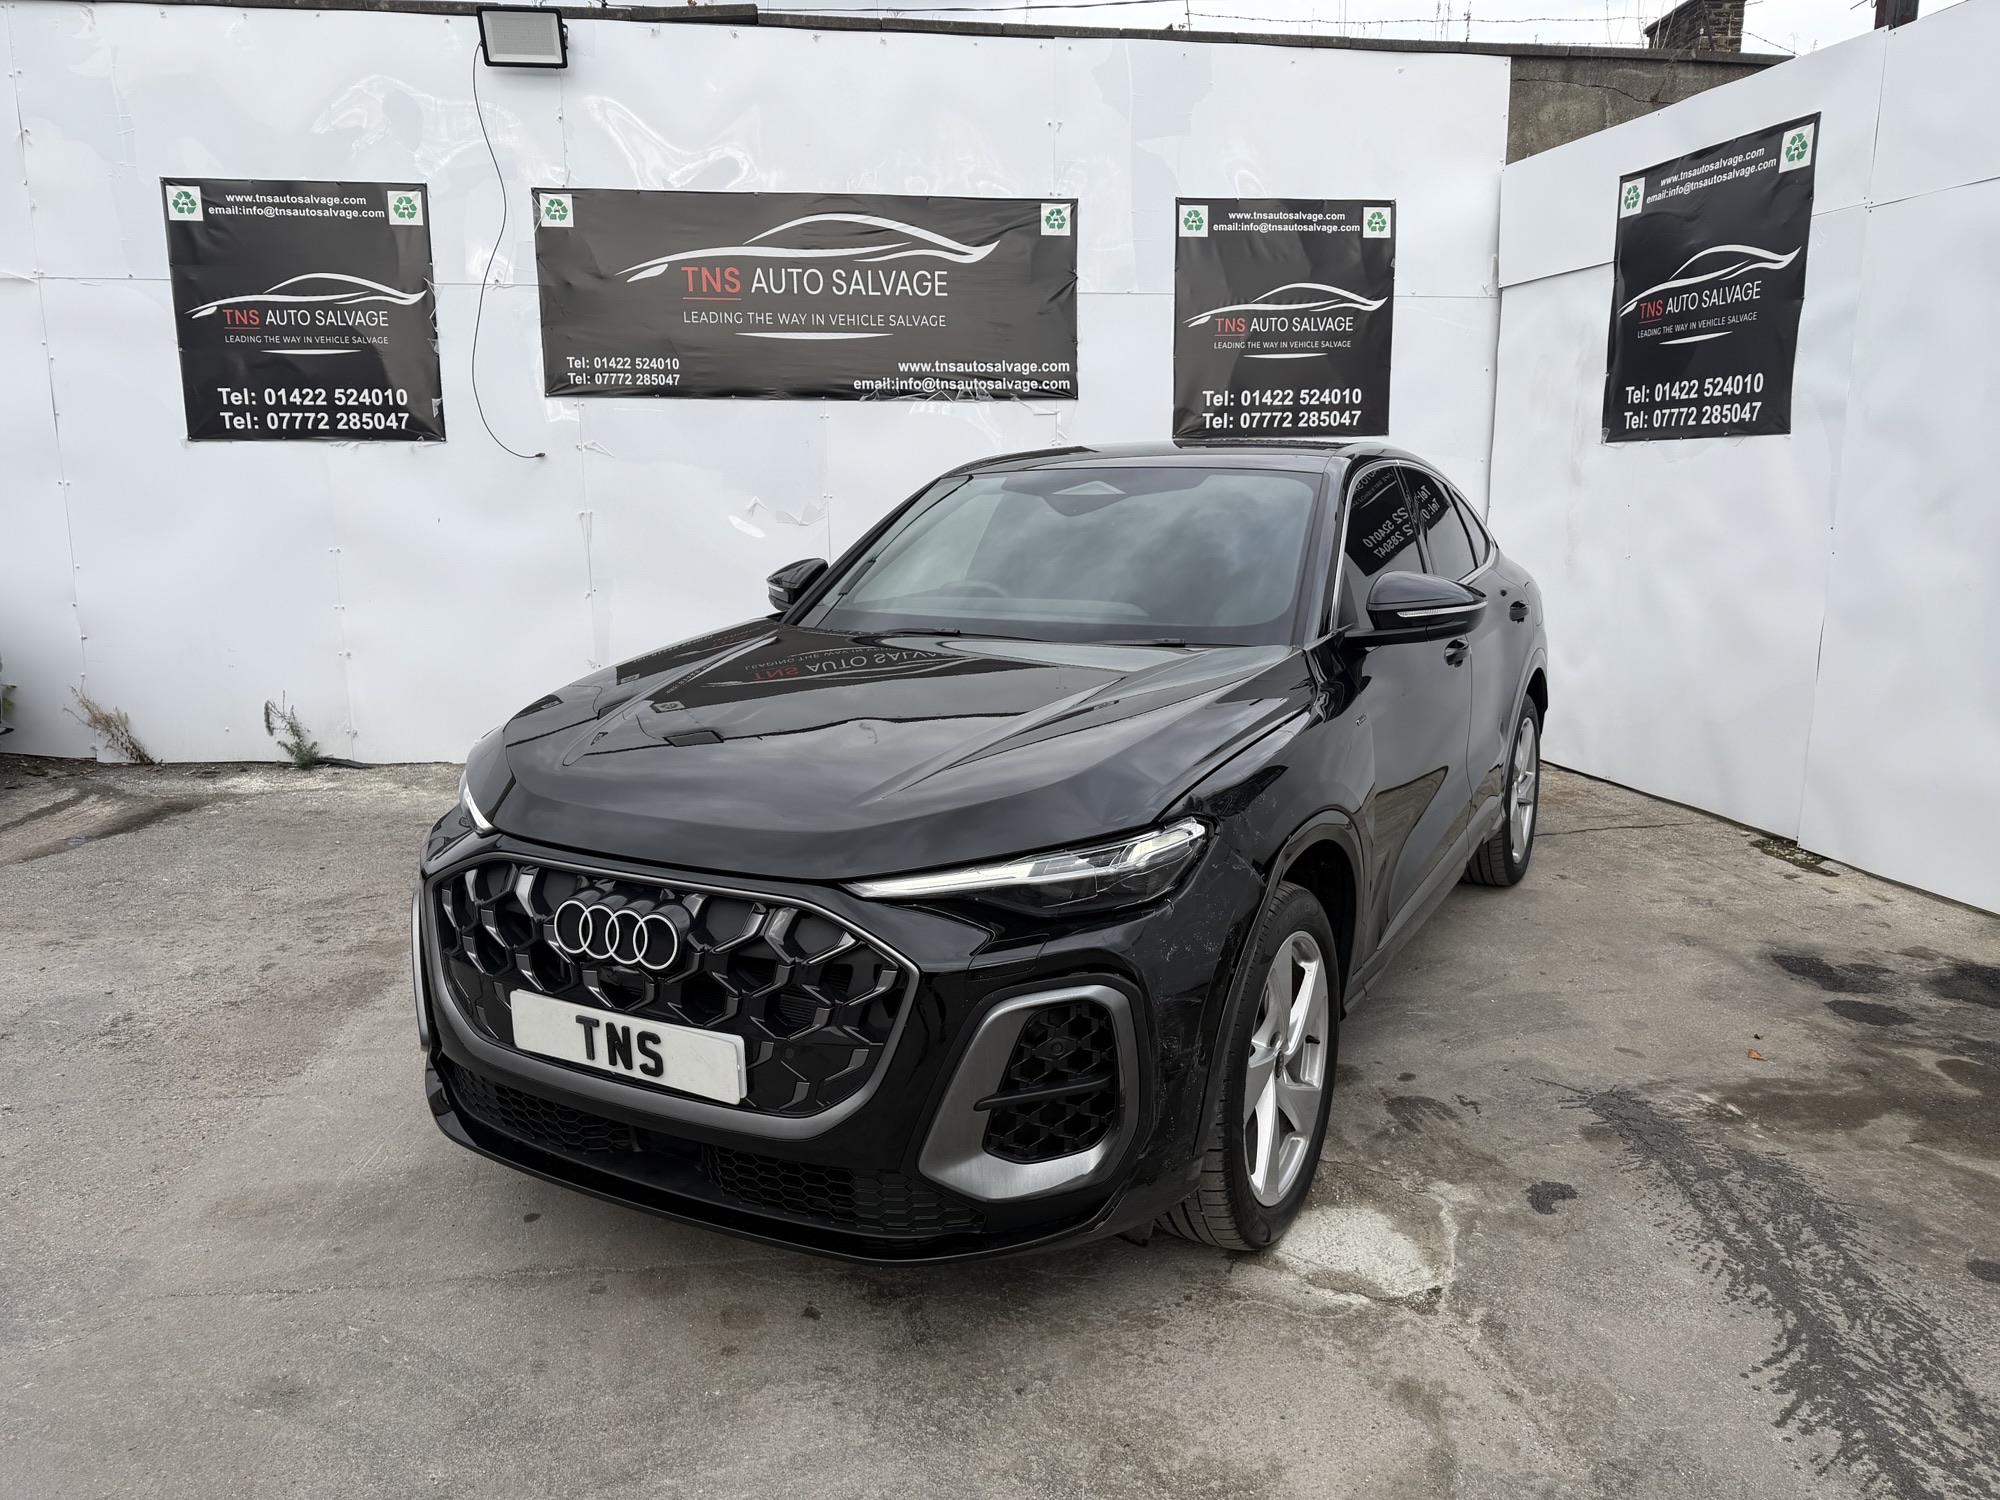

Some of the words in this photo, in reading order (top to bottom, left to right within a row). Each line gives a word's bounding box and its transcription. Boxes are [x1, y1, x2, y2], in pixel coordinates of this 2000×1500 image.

[1660, 147, 1765, 187] www.tnsautosalvage.com
[1646, 158, 1777, 204] email:info@tnsautosalvage.com
[225, 194, 366, 206] www.tnsautosalvage.com
[208, 206, 385, 219] email:info@tnsautosalvage.com
[1228, 211, 1345, 222] www.tnsautosalvage.com
[1213, 222, 1360, 233] email:info@tnsautosalvage.com
[681, 267, 741, 293] TNS
[751, 268, 823, 294] AUTO
[832, 269, 948, 296] SALVAGE
[1640, 299, 1663, 319] TNS
[1665, 292, 1699, 314] AUTO
[1701, 280, 1762, 308] SALVAGE
[222, 309, 259, 325] TNS
[266, 310, 310, 325] AUTO
[315, 310, 389, 326] SALVAGE
[684, 311, 743, 324] LEADING
[747, 312, 773, 324] THE
[778, 313, 807, 325] WAY
[812, 314, 824, 325] IN
[829, 314, 884, 326] VEHICLE
[889, 315, 946, 327] SALVAGE
[1215, 318, 1245, 332] TNS
[1250, 317, 1288, 332] AUTO
[1292, 317, 1353, 332] SALVAGE
[1637, 327, 1662, 338] LEADING
[1663, 325, 1673, 334] THE
[1675, 323, 1688, 332] WAY
[1689, 321, 1697, 330] IN
[1698, 316, 1726, 328] VEHICLE
[1727, 311, 1758, 324] SALVAGE
[225, 335, 261, 343] LEADING
[314, 336, 349, 344] VEHICLE
[352, 336, 389, 344] SALVAGE
[566, 357, 589, 368] Tel:
[594, 357, 631, 369] 01422
[636, 358, 679, 370] 524010
[898, 360, 1070, 375] www.tnsautosalvage.com
[567, 373, 590, 384] Tel:
[595, 373, 632, 385] 07772
[636, 374, 680, 385] 285047
[853, 376, 1070, 392] email:info@tnsautosalvage.com
[217, 388, 256, 405] Tel:
[264, 388, 327, 405] 01422
[335, 389, 408, 405] 524010
[1202, 390, 1234, 406] Tel:
[1241, 390, 1293, 406] 01422
[1300, 388, 1362, 405] 524010
[1626, 385, 1649, 404] Tel:
[1655, 380, 1698, 401] 01422
[1704, 373, 1763, 397] 524010
[220, 412, 259, 429] Tel:
[267, 412, 329, 429] 07772
[336, 413, 409, 429] 285047
[1202, 413, 1233, 428] Tel:
[1240, 412, 1292, 428] 07772
[1298, 410, 1361, 427] 285047
[1624, 411, 1648, 429] Tel:
[1653, 407, 1697, 427] 07772
[1701, 402, 1762, 424] 285047
[575, 1015, 664, 1077] TNS
